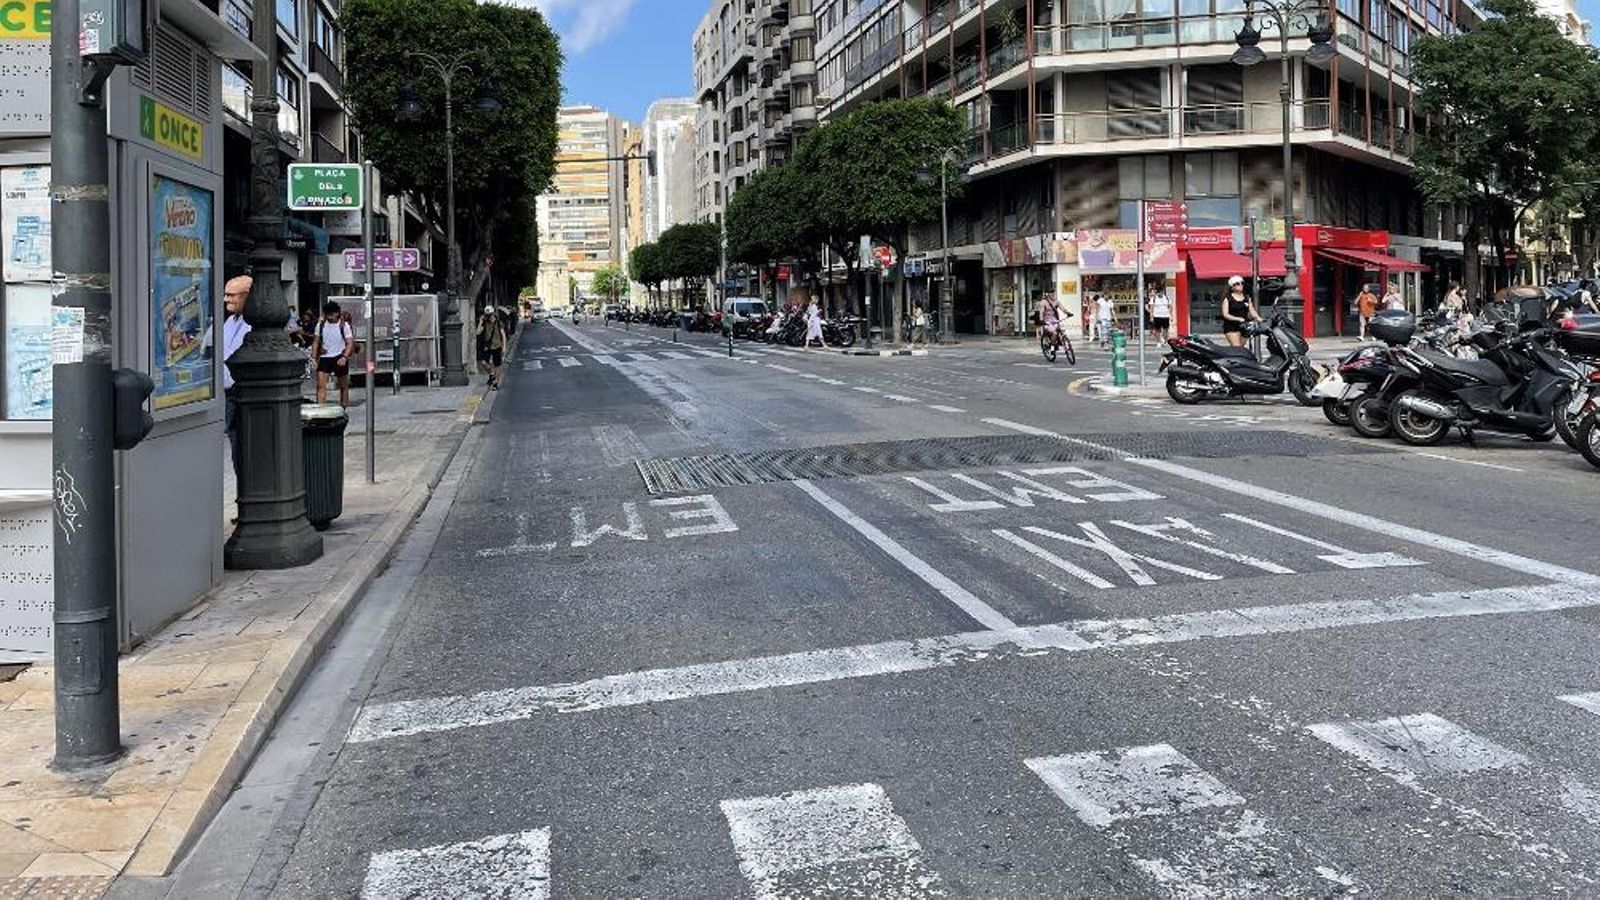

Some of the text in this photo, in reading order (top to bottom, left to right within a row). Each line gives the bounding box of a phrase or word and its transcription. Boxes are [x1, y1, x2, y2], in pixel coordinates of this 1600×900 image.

[160, 113, 198, 153] ONCE
[319, 182, 343, 190] DELS
[904, 466, 1167, 513] EMT
[474, 494, 739, 557] EMT
[991, 513, 1430, 589] TAXI
